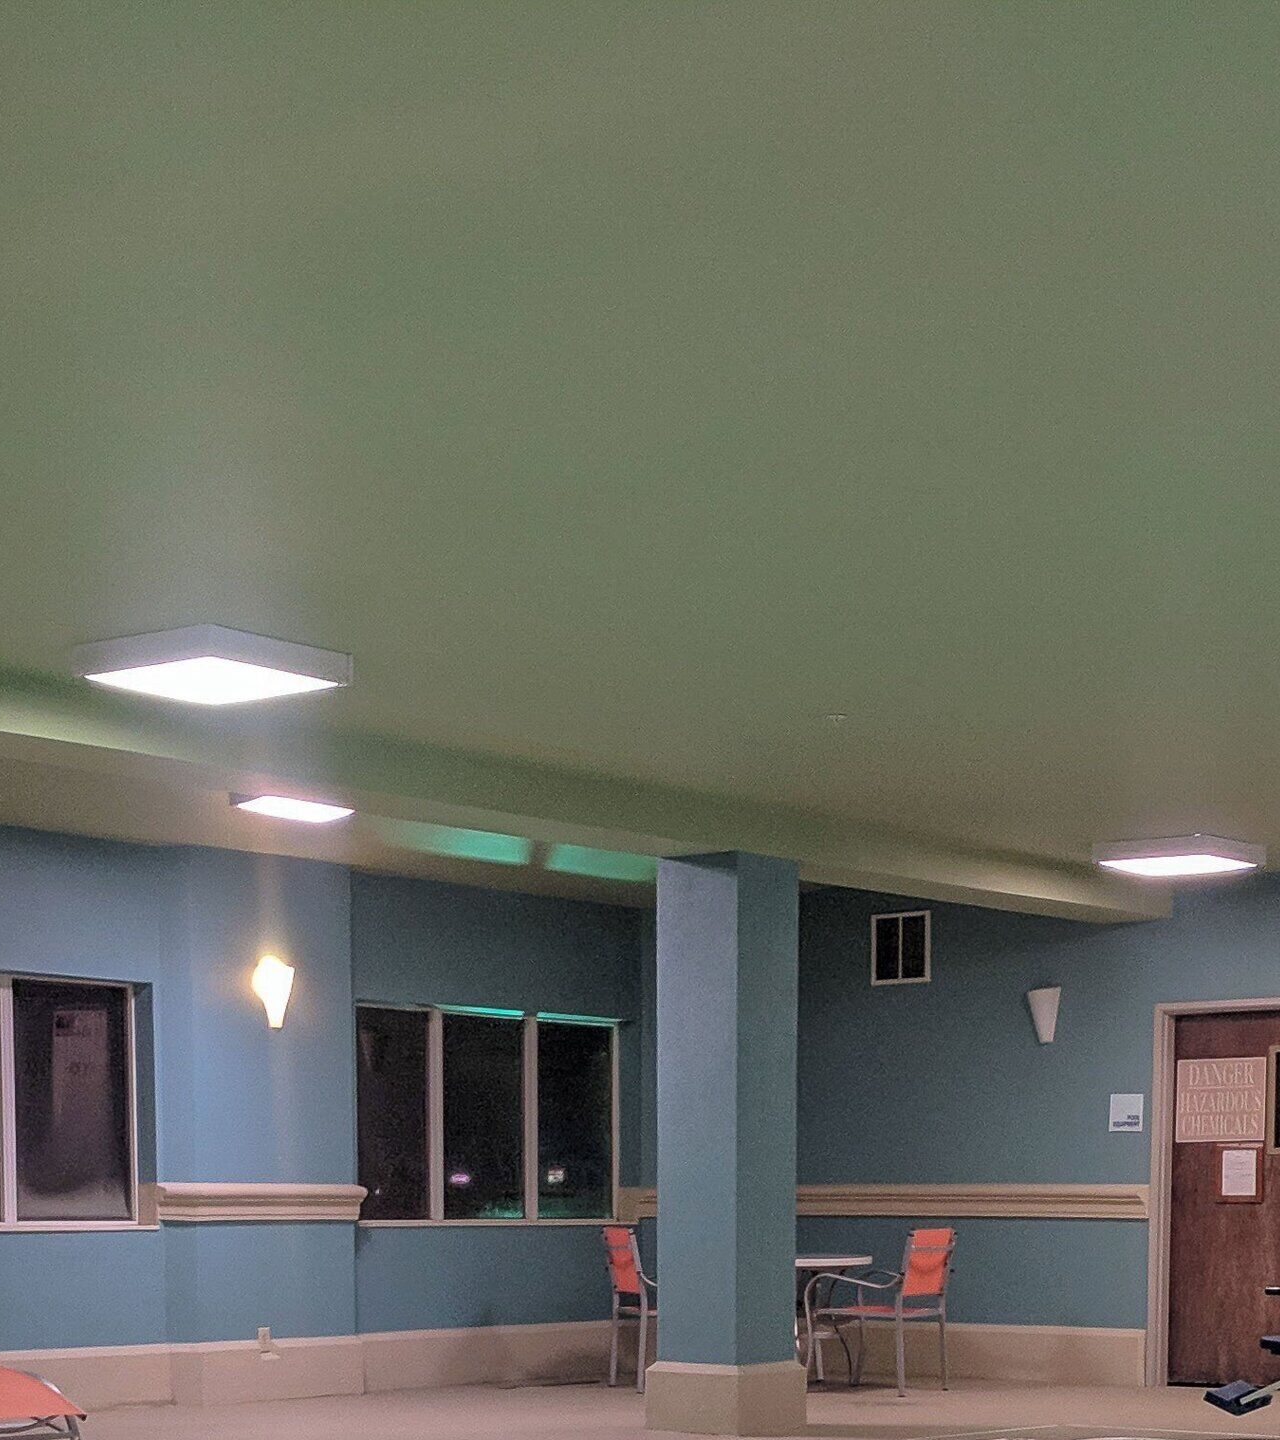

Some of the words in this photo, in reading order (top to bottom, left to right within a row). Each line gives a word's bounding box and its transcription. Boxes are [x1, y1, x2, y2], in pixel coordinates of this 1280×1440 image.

[1189, 1062, 1255, 1085] DANGER
[1180, 1088, 1261, 1112] HAZARDOUS
[1182, 1111, 1259, 1136] CHEMICALS
